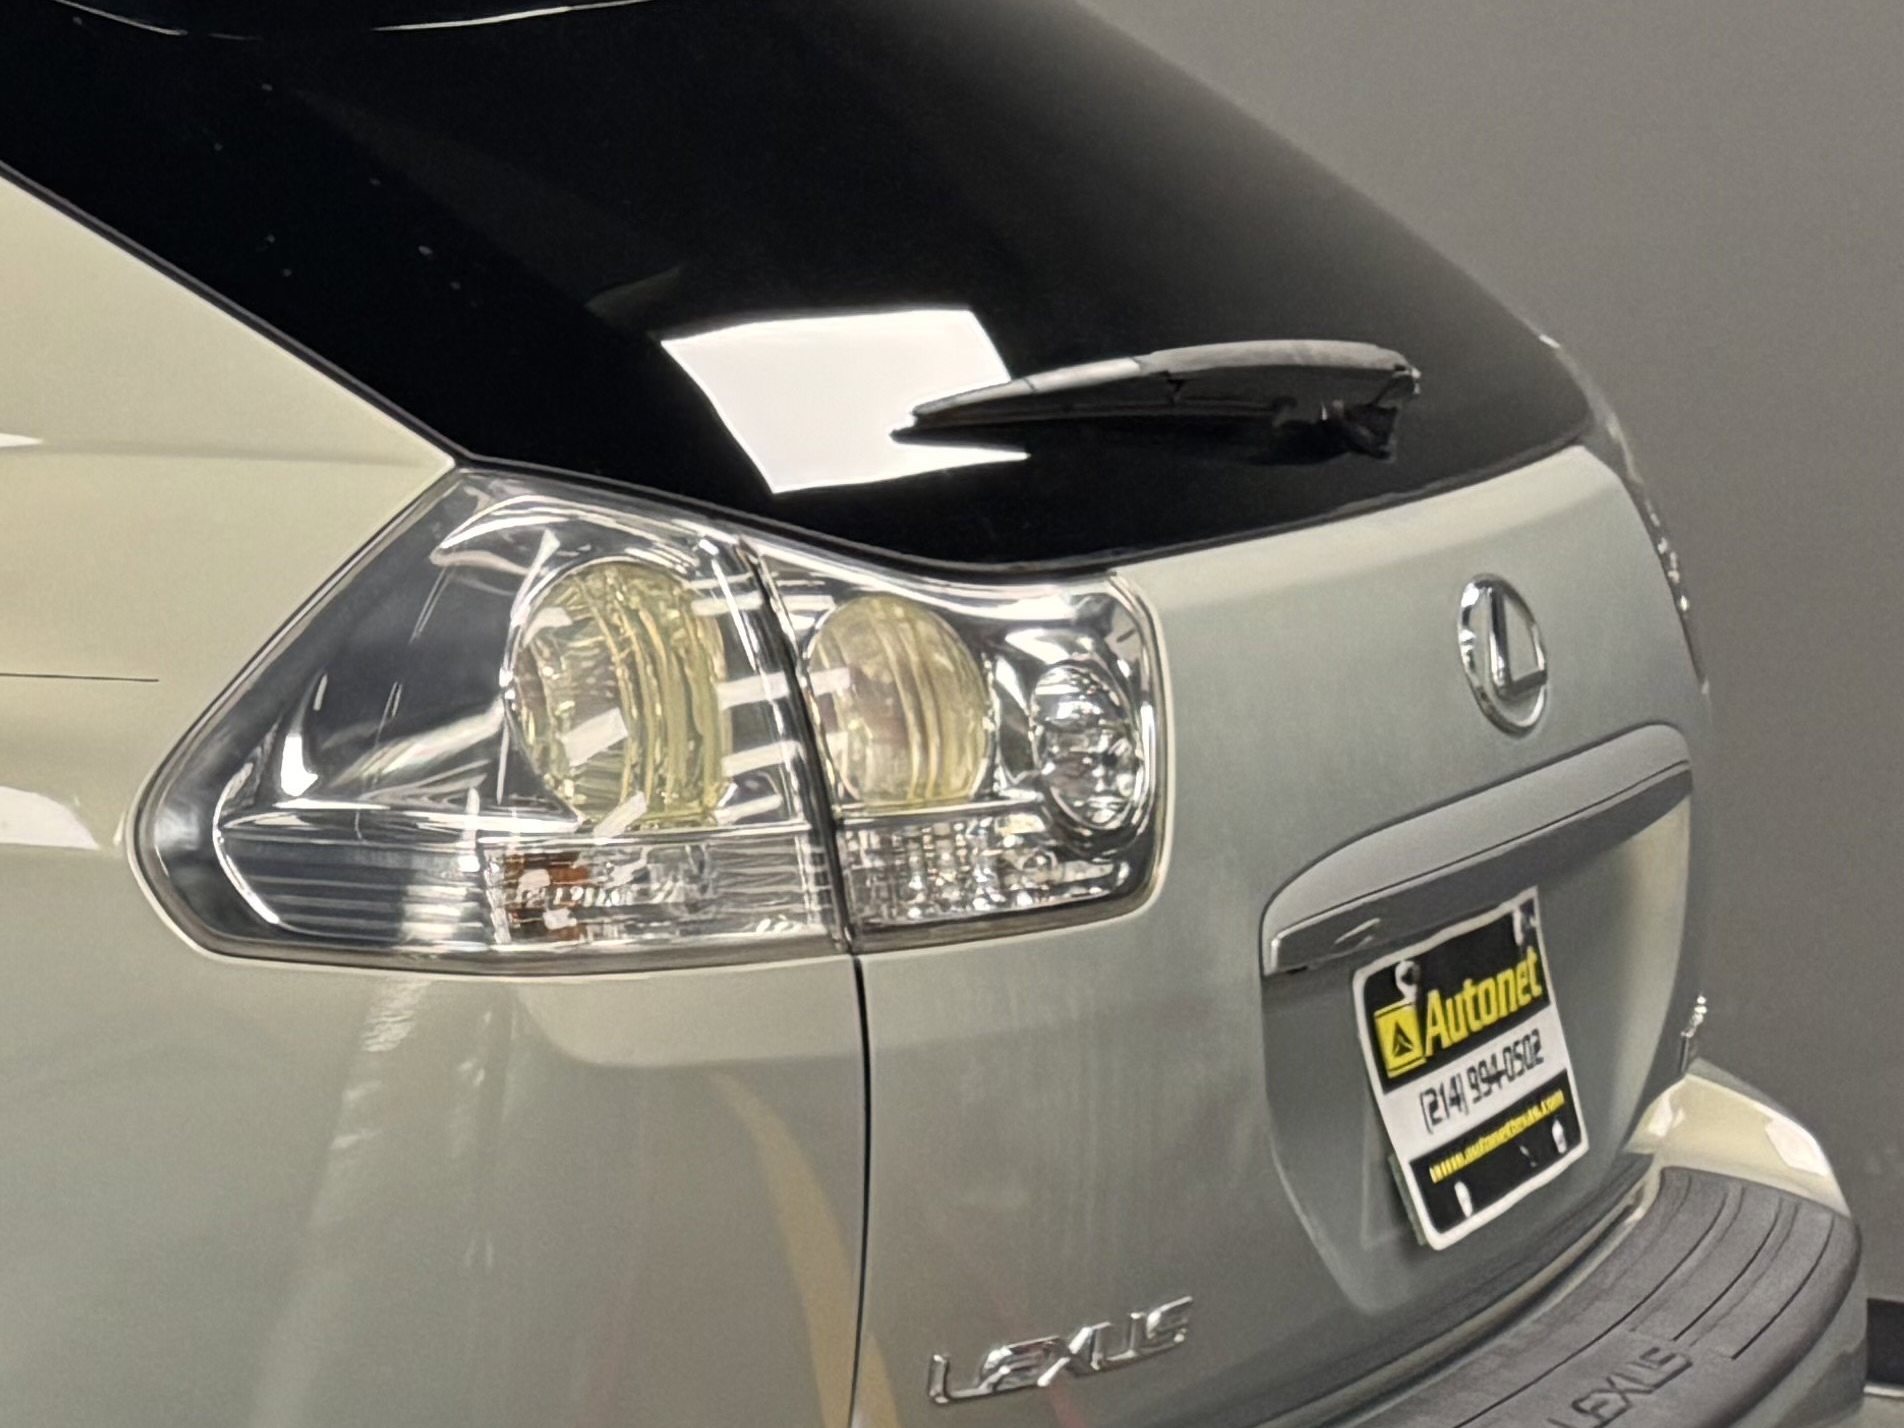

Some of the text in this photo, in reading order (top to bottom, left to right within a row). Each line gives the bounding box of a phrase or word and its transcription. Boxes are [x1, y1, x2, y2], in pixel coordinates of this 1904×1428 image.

[1424, 945, 1543, 1057] Autonet
[1466, 1027, 1545, 1104] 994-0502
[928, 1295, 1194, 1405] LEXUS
